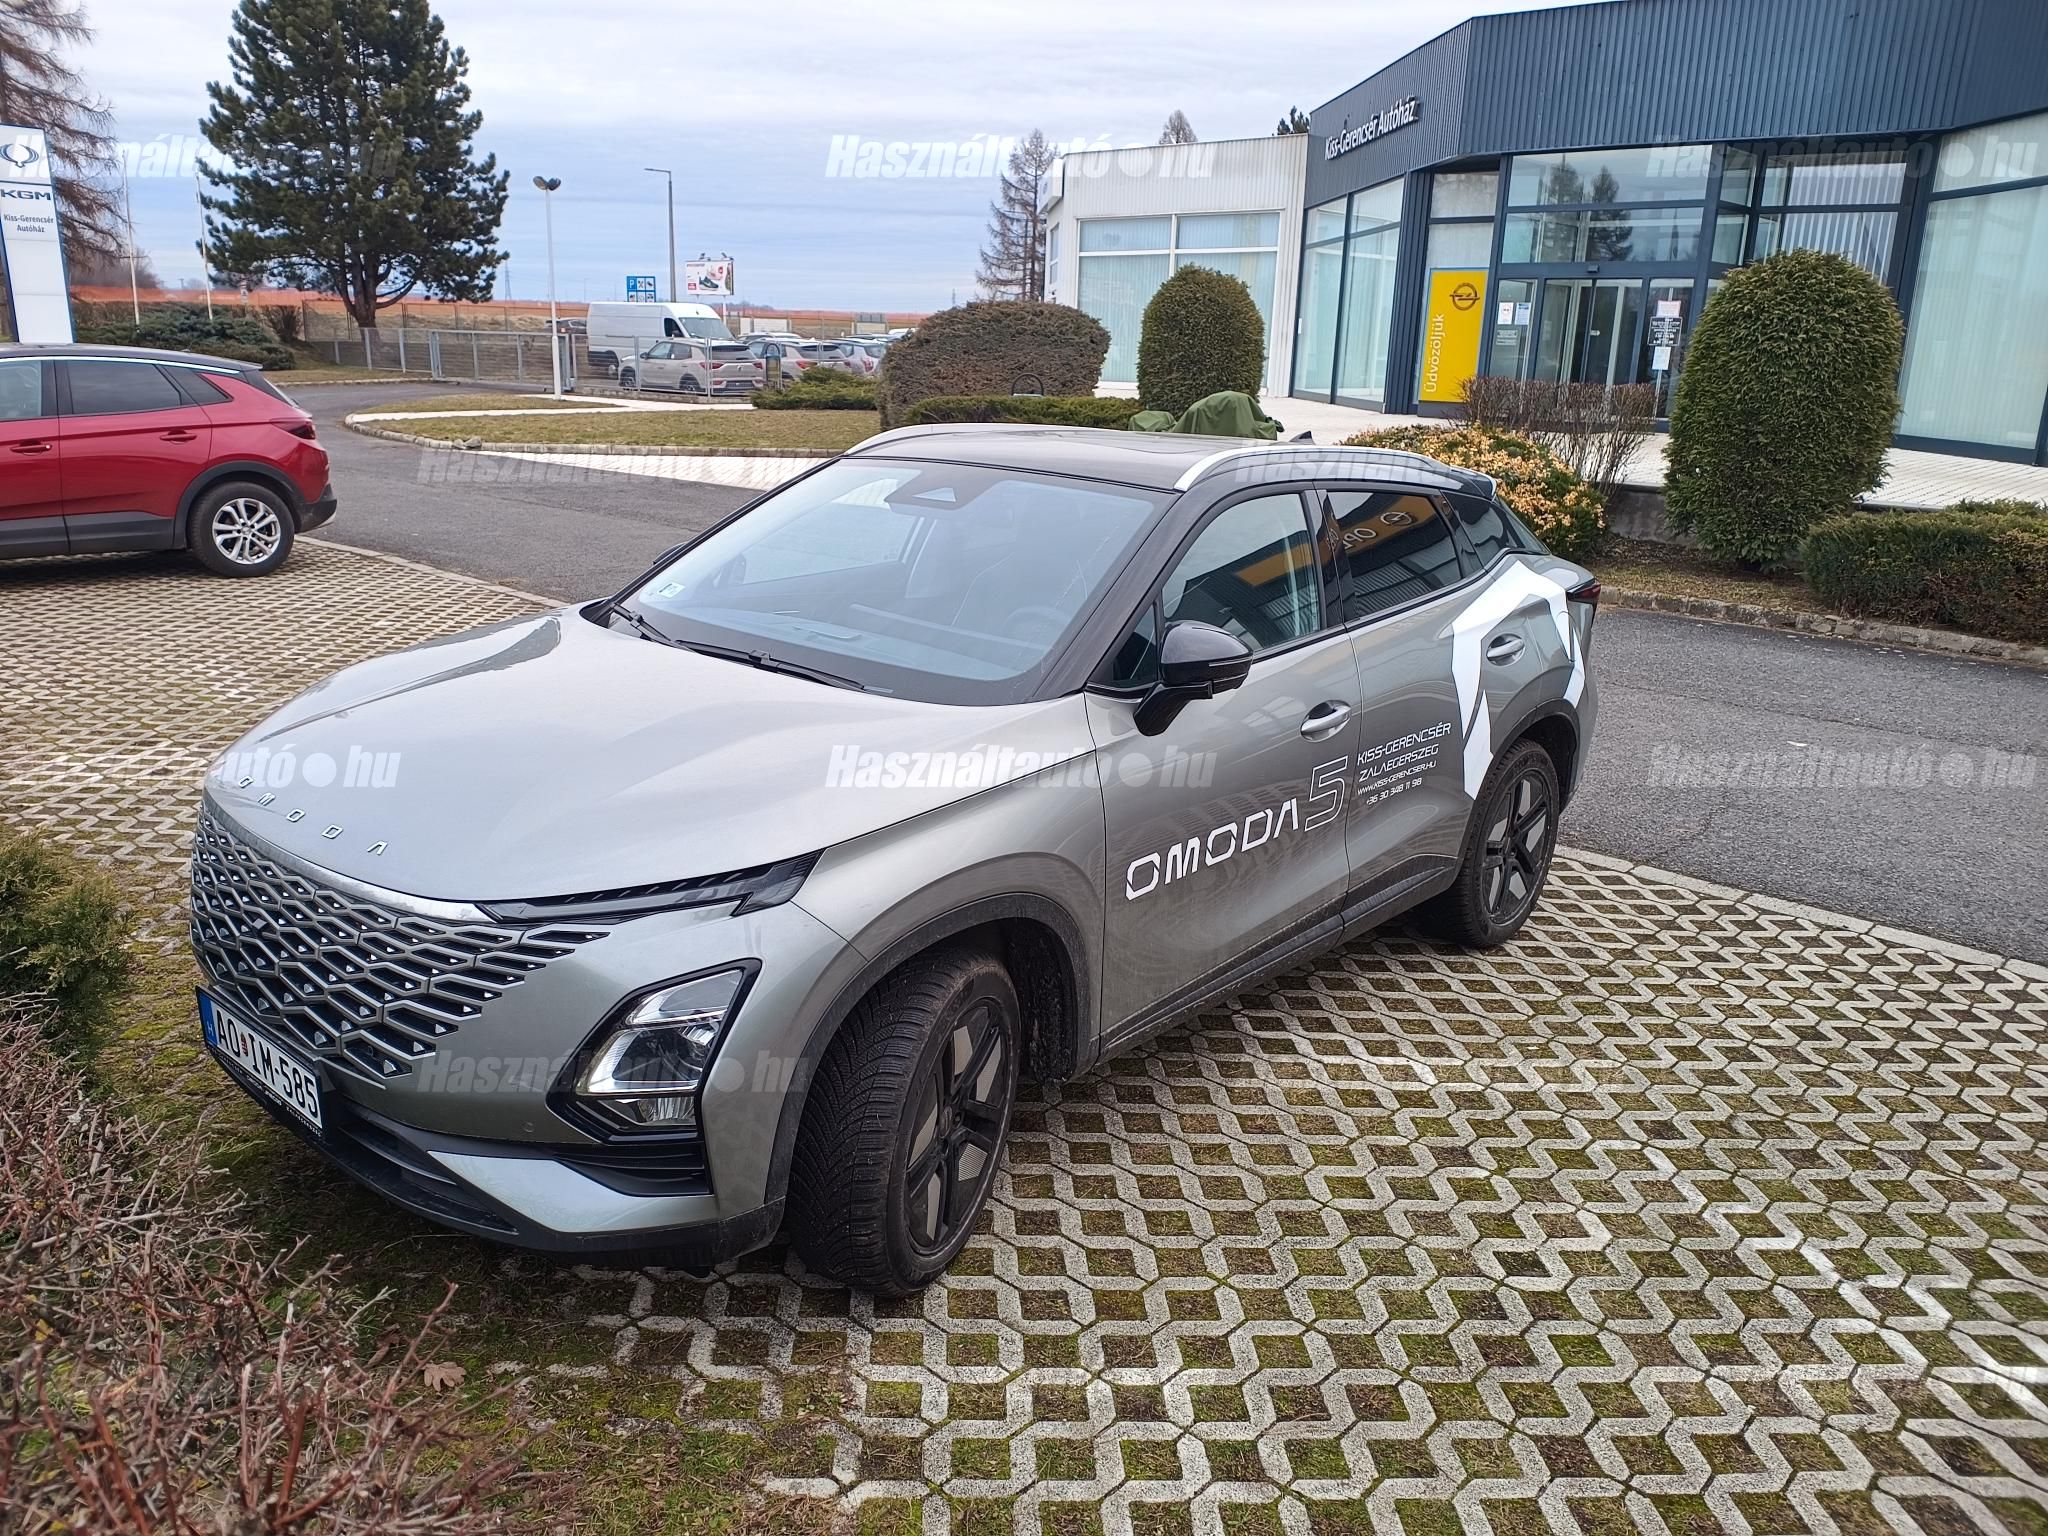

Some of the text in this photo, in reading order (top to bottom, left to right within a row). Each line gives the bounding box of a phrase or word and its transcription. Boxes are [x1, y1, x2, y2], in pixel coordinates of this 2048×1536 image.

[1325, 95, 1418, 160] Kiss-Gerencsér Autóház
[0, 188, 51, 200] KGM
[1424, 313, 1445, 392] Üdvözöljük
[1357, 722, 1451, 766] KISS-GERENCSÉR
[1359, 744, 1439, 782] ZALAEGERSZEG
[238, 776, 388, 855] OMODA
[1125, 755, 1348, 901] OMODA 5
